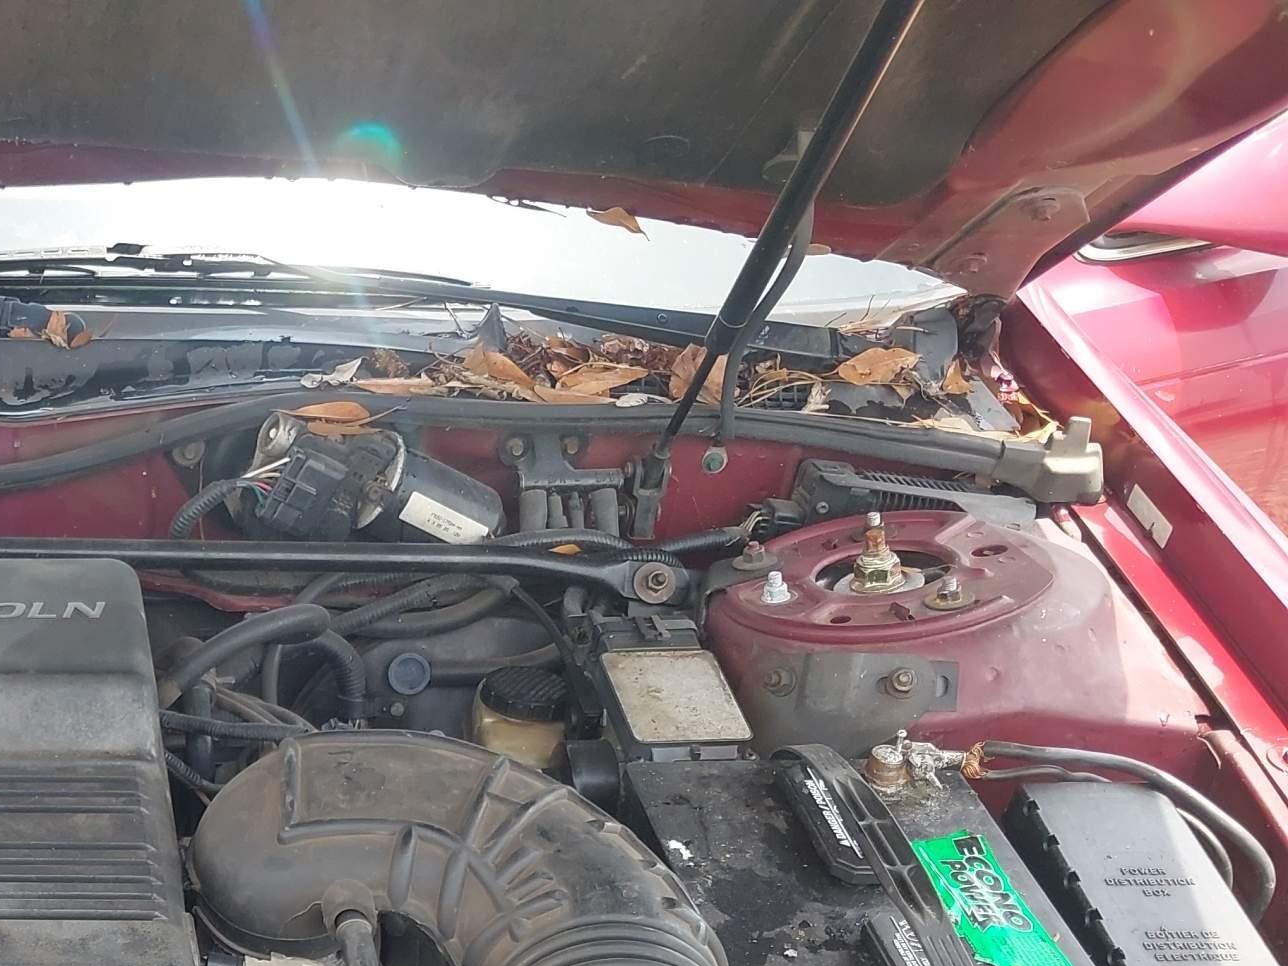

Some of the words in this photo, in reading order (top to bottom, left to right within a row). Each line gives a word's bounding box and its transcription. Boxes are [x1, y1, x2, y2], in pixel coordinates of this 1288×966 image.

[1120, 867, 1167, 876] POWER
[952, 835, 1034, 933] ECONO
[1104, 877, 1196, 887] DISTRIBUTION
[938, 860, 1005, 933] POWER
[1143, 889, 1172, 897] BOX
[1201, 931, 1220, 939] DE
[1143, 942, 1238, 951] DISTRIBUTION
